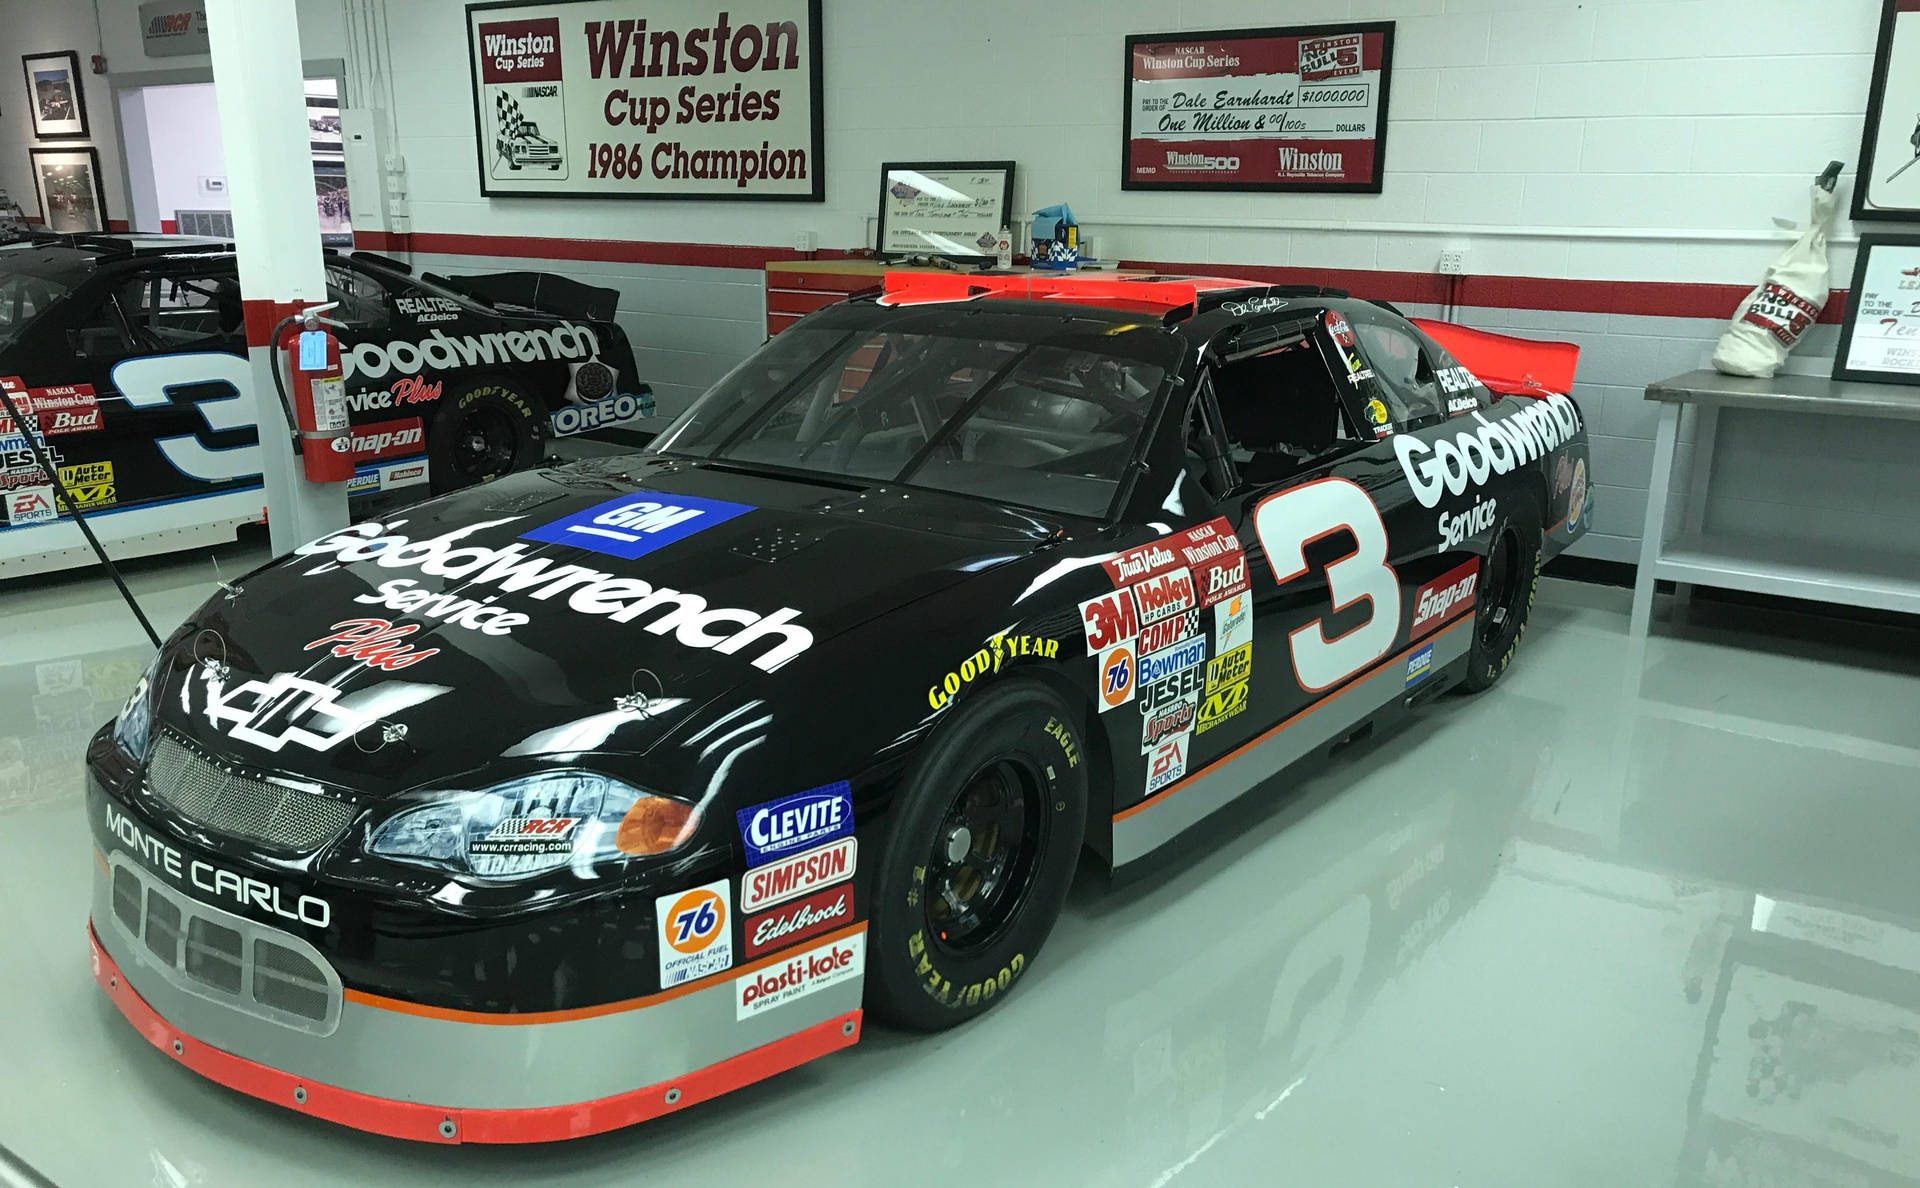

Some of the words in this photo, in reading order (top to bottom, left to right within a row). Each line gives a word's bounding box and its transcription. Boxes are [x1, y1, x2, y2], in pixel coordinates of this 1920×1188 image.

[485, 32, 555, 57] Winston
[584, 12, 800, 79] Winston
[1175, 47, 1205, 56] NASCAR
[1305, 49, 1329, 62] NO
[1337, 47, 1358, 66] 5
[1314, 38, 1358, 49] WINSTON
[495, 57, 514, 71] Cup
[517, 55, 544, 69] Series
[1143, 57, 1183, 69] Winston
[1185, 56, 1205, 69] Cup
[1207, 55, 1240, 68] Series
[1300, 52, 1337, 73] BULL
[1333, 68, 1359, 76] EVENT
[534, 86, 558, 98] NASCAR
[1172, 92, 1206, 109] Dale
[1214, 89, 1294, 109] Earnhardt
[604, 89, 670, 133] Cup
[676, 83, 781, 124] Series
[1158, 113, 1186, 132] One
[1193, 112, 1250, 132] Million
[1336, 124, 1366, 133] DOLLARS
[588, 143, 643, 180] 1986
[651, 141, 807, 187] Champion
[1166, 151, 1204, 166] Winston
[1204, 157, 1240, 170] 500
[1278, 147, 1343, 171] Winston
[1747, 304, 1794, 321] BULL
[33, 397, 75, 409] Winston
[75, 393, 97, 405] Cup
[46, 387, 76, 396] NASCAR
[391, 374, 443, 407] Plus
[52, 409, 99, 428] Bud
[110, 351, 265, 482] 3
[556, 395, 636, 432] OREO
[350, 427, 422, 454] nap-on
[74, 472, 111, 486] Meter
[76, 465, 105, 475] Auto
[346, 474, 379, 488] PERDUE
[14, 494, 50, 514] EA
[14, 509, 52, 521] SPORTS
[593, 501, 706, 534] GM
[1187, 525, 1216, 542] NASCAR
[1437, 495, 1496, 553] Service
[1181, 540, 1220, 565] Winston
[1218, 534, 1239, 553] Cup
[1209, 557, 1245, 594] Bud
[1253, 476, 1401, 694] 3
[295, 519, 814, 675] Goodwrench
[353, 578, 530, 635] Service
[1136, 573, 1194, 613] Holley
[1204, 593, 1223, 607] POLE
[1224, 583, 1247, 597] AWARD
[1414, 573, 1478, 627] Snap-on
[1085, 591, 1138, 650] 3M
[1144, 612, 1155, 623] HP
[1157, 602, 1181, 618] CARBS
[303, 618, 441, 671] Plus
[1138, 615, 1185, 656] COMP
[929, 634, 1060, 711] GOODYEAR
[1139, 641, 1205, 686] Bowman
[1222, 649, 1246, 670] Auto
[1407, 649, 1433, 676] PERDUE
[1106, 657, 1129, 695] 76
[1219, 660, 1249, 688] Meter
[1140, 666, 1204, 714] JESEL
[1144, 703, 1195, 743] Sports
[1196, 712, 1229, 736] MECHANIX
[1229, 701, 1247, 720] WEAR
[1044, 717, 1080, 769] EAGLE
[1150, 765, 1182, 791] SPORTS
[520, 819, 572, 834] RCR
[750, 796, 843, 848] CLEVITE
[472, 842, 571, 854] www.rcrracing.com
[761, 837, 802, 854] ENGINE
[806, 824, 841, 841] PARTS
[105, 803, 183, 879] MONTE
[190, 863, 331, 929] CARLO
[751, 846, 848, 904] SIMPSON
[674, 898, 717, 944] 76
[752, 894, 847, 948] Edelbrock
[665, 952, 704, 970] OFFICIAL
[707, 944, 729, 957] FUEL
[742, 946, 854, 1006] plasti-kote
[753, 993, 781, 1011] SPRAY
[782, 985, 806, 1001] PAINT
